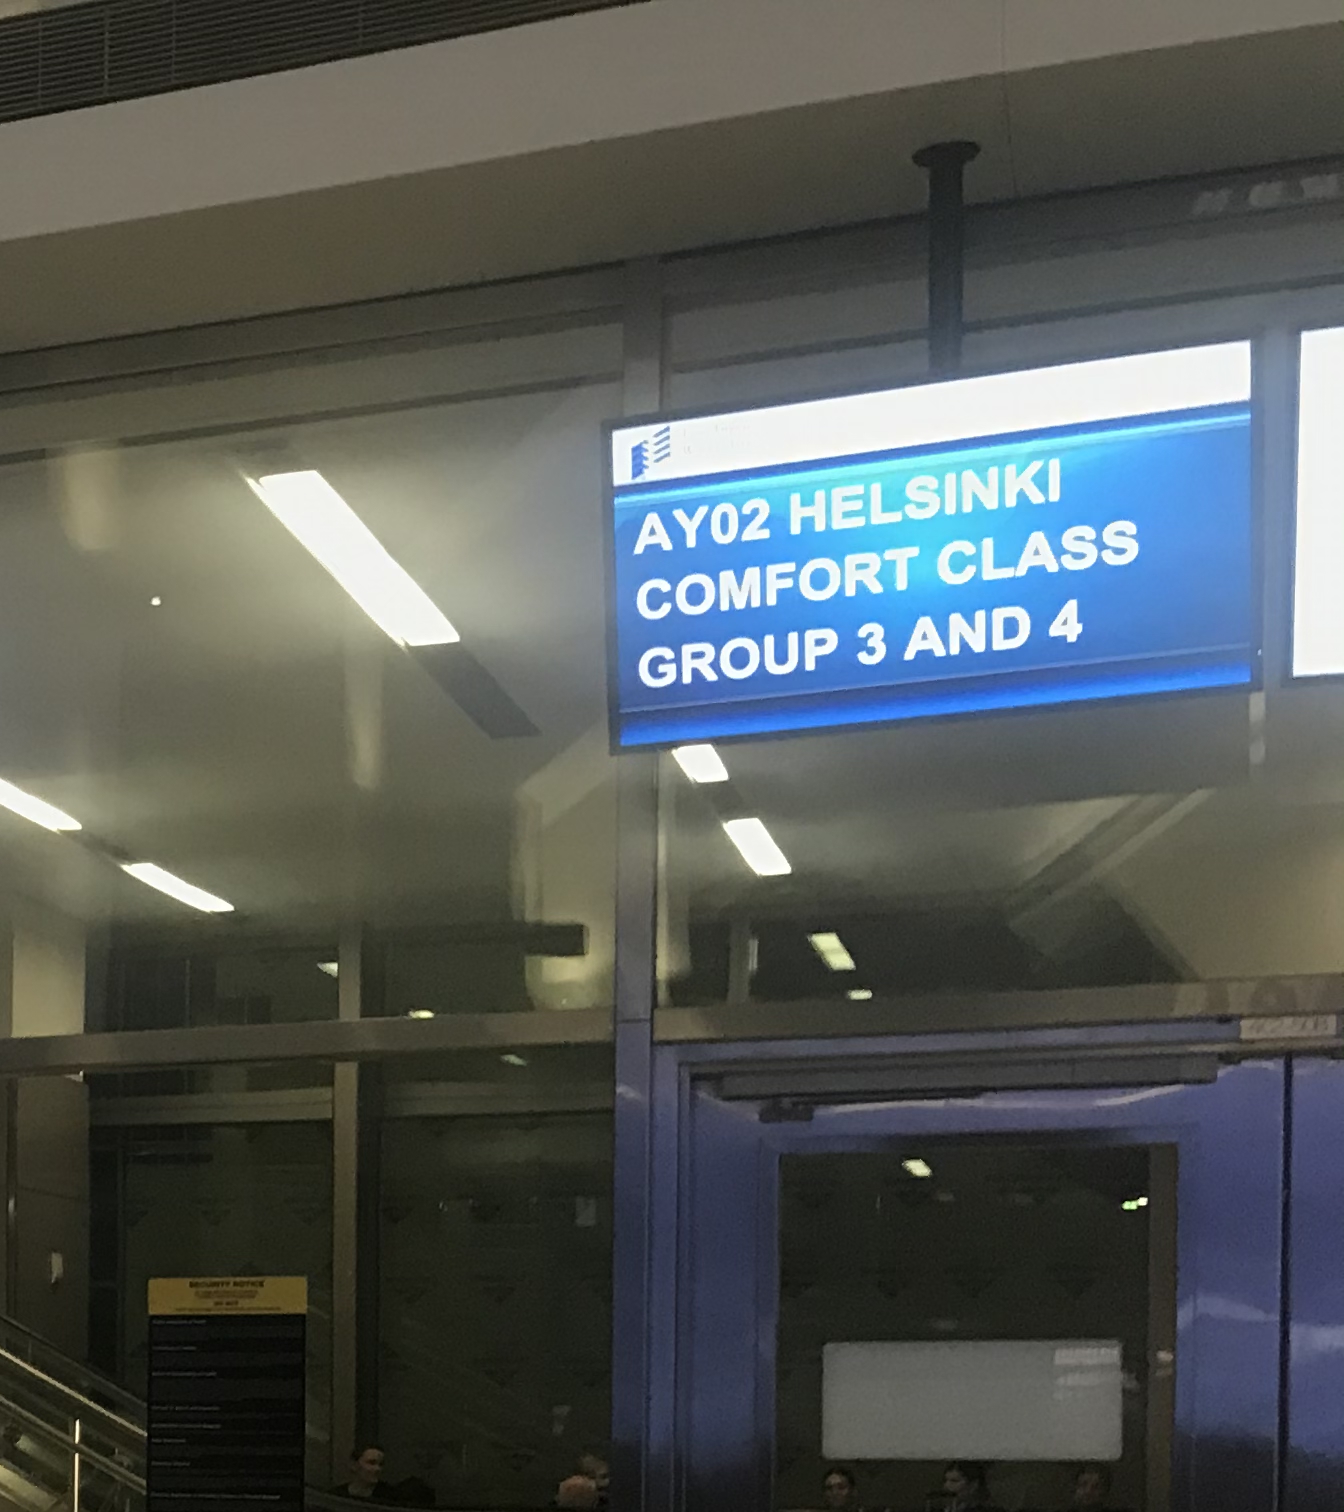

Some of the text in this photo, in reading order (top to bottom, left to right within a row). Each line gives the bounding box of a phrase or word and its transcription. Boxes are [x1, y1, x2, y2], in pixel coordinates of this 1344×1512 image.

[633, 458, 1061, 555] AY02 HELSINKI
[636, 520, 1140, 620] COMFORT CLASS
[638, 600, 1083, 688] GROUP 3 AND 4
